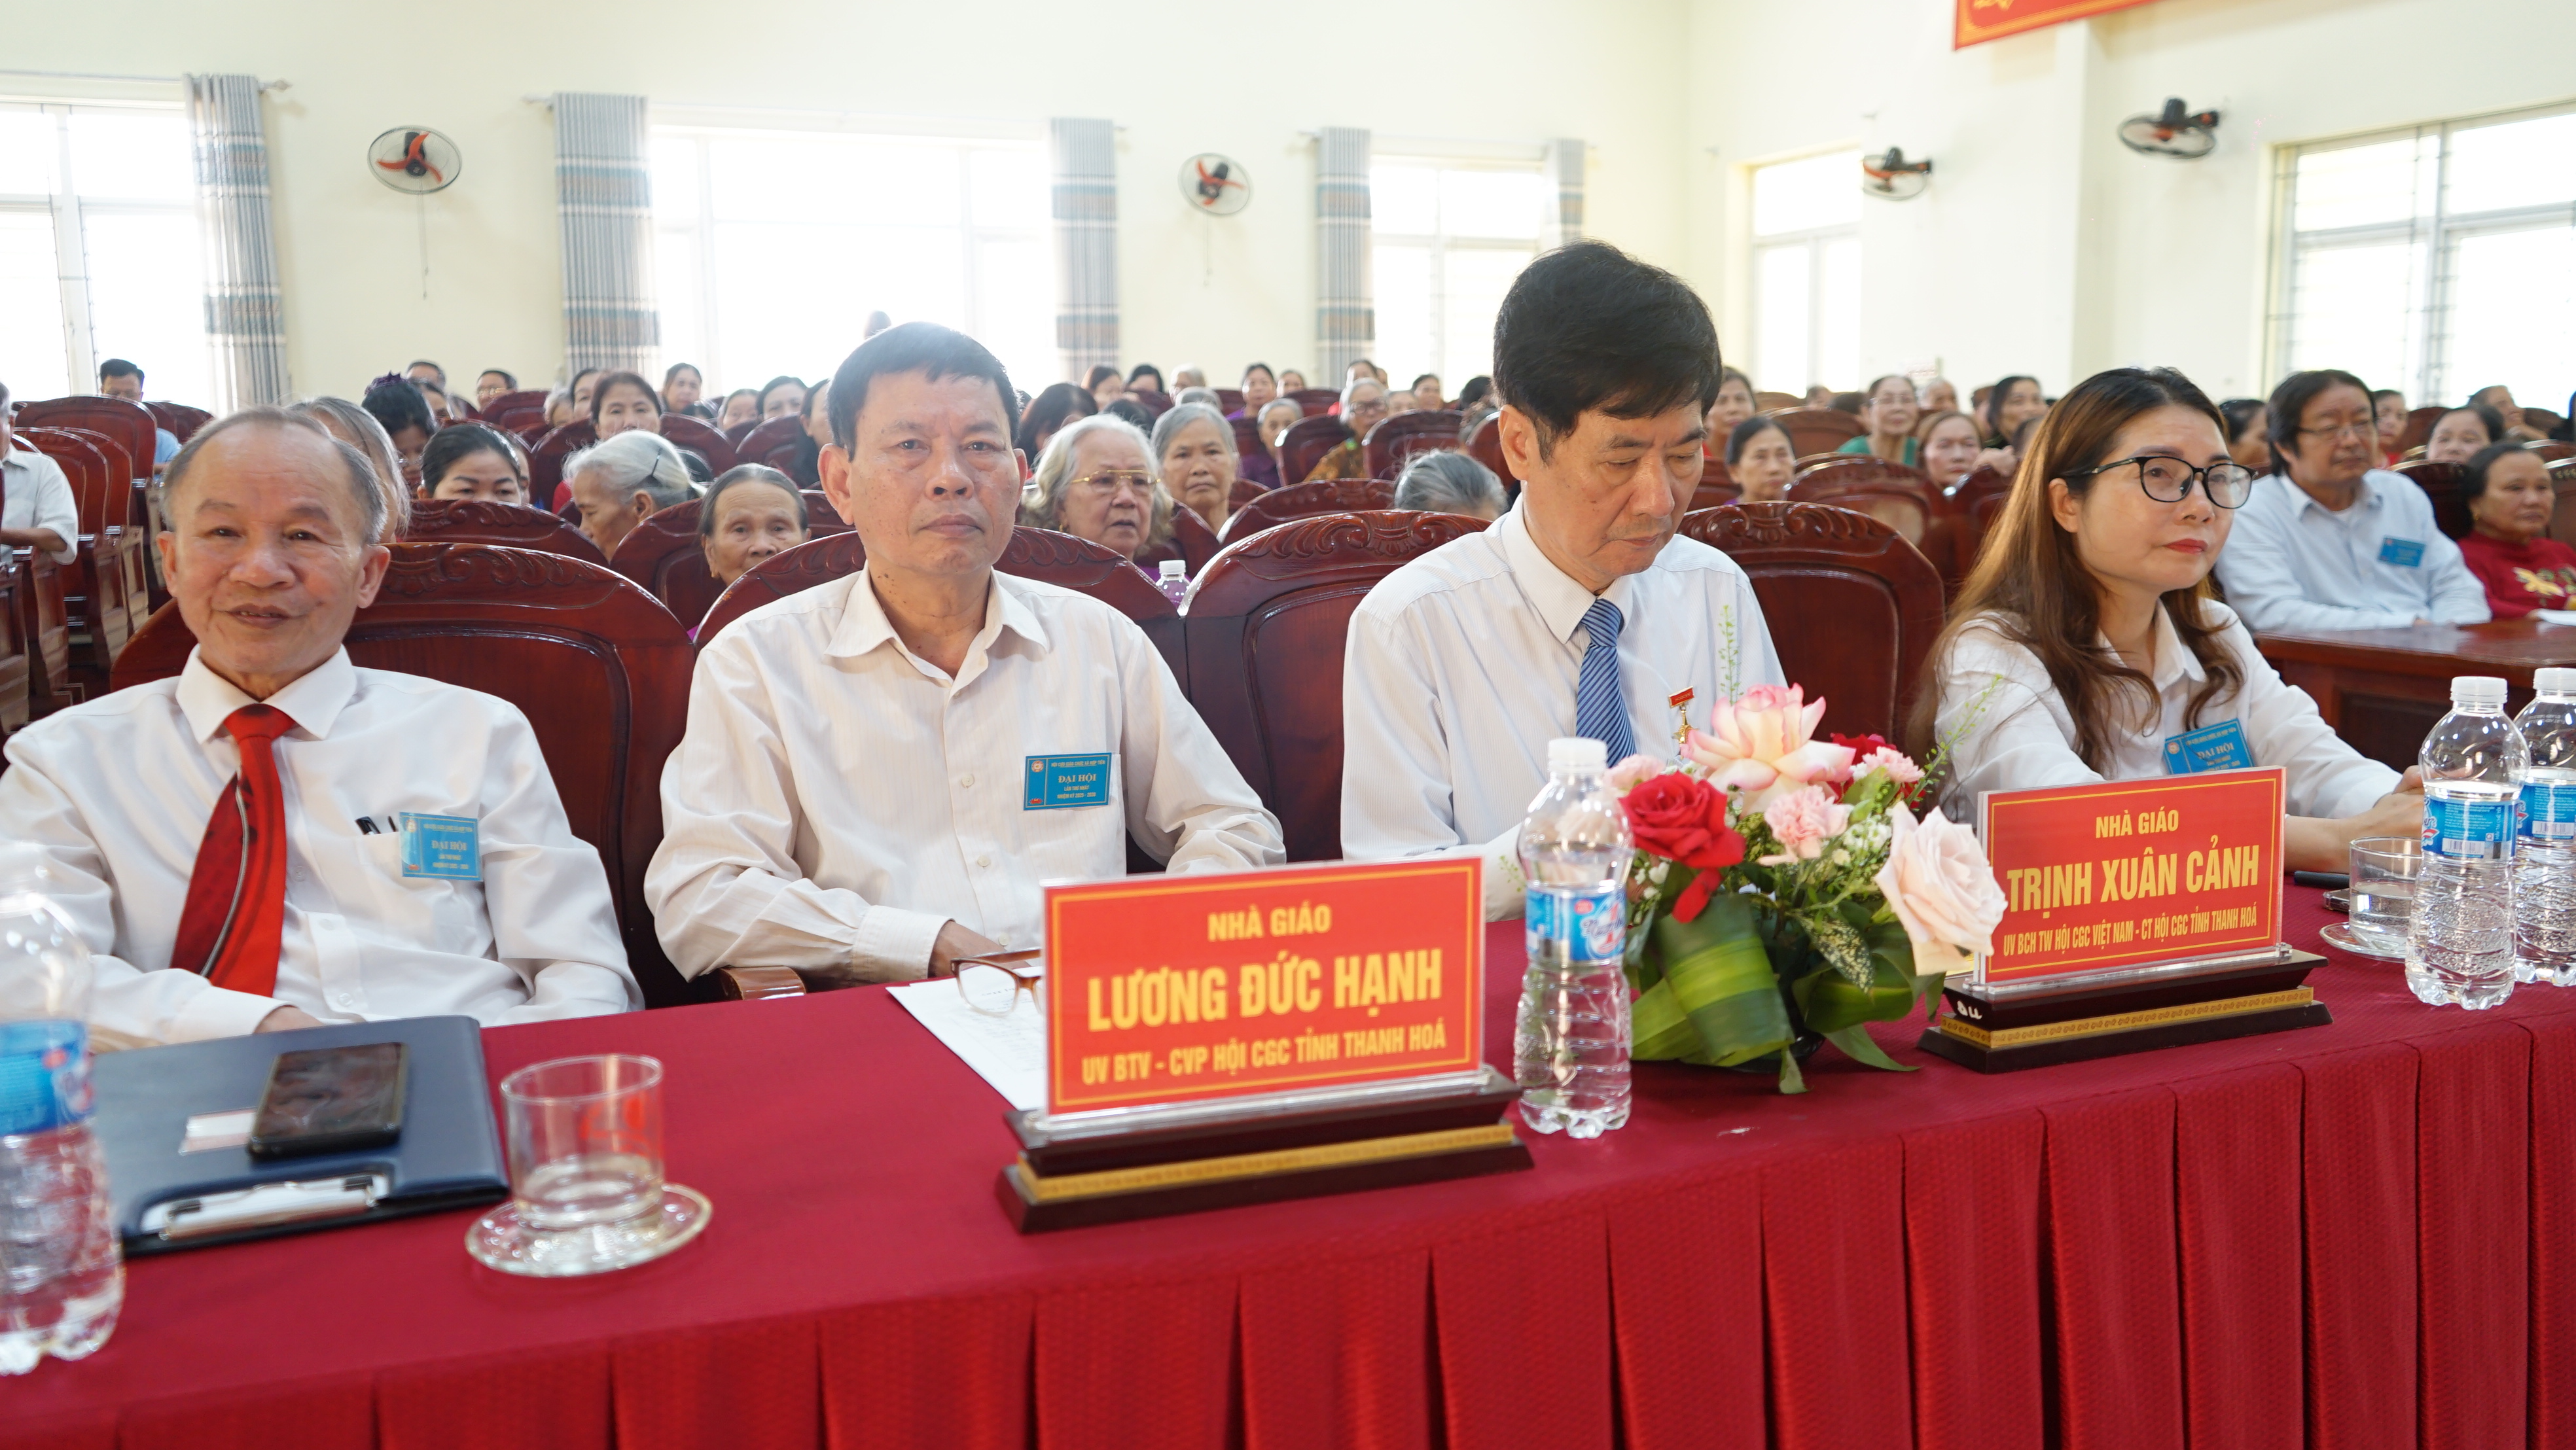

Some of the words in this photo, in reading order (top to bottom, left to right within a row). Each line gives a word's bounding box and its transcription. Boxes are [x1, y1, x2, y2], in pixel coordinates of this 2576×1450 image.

[1058, 775, 1076, 784] ĐẠI
[1078, 773, 1097, 783] HỘI
[2096, 809, 2133, 839] NHÀ
[2138, 805, 2179, 834] GIÁO
[2007, 862, 2092, 919] TRỊNH
[2100, 846, 2177, 903] XUÂN
[2186, 834, 2259, 893] CẢNH
[1208, 906, 1264, 942] NHÀ
[1270, 901, 1332, 937] GIÁO
[2003, 934, 2016, 957] UV
[2017, 932, 2037, 955] BCH
[2038, 930, 2053, 952] TW
[2054, 924, 2071, 955] HỘI
[2072, 925, 2090, 948] CGC
[2092, 918, 2112, 949] VIỆT
[2113, 920, 2134, 944] NAM
[2141, 918, 2153, 940] CT
[2154, 912, 2170, 943] HỘI
[2171, 913, 2189, 936] CGC
[2190, 905, 2210, 934] TỈNH
[2211, 908, 2239, 932] THANH
[2240, 902, 2257, 928] HOÁ
[1087, 965, 1228, 1032] LƯƠNG
[1238, 950, 1323, 1018] ĐỨC
[1333, 947, 1442, 1017] HẠNH
[1082, 1056, 1110, 1086] UV
[1113, 1052, 1152, 1082] BTV
[1169, 1046, 1209, 1077] CVP
[1212, 1038, 1247, 1076] HỘI
[1251, 1038, 1291, 1069] CGC
[1295, 1027, 1340, 1064] TỈNH
[1342, 1026, 1406, 1059] THANH
[1408, 1017, 1447, 1052] HOÁ
